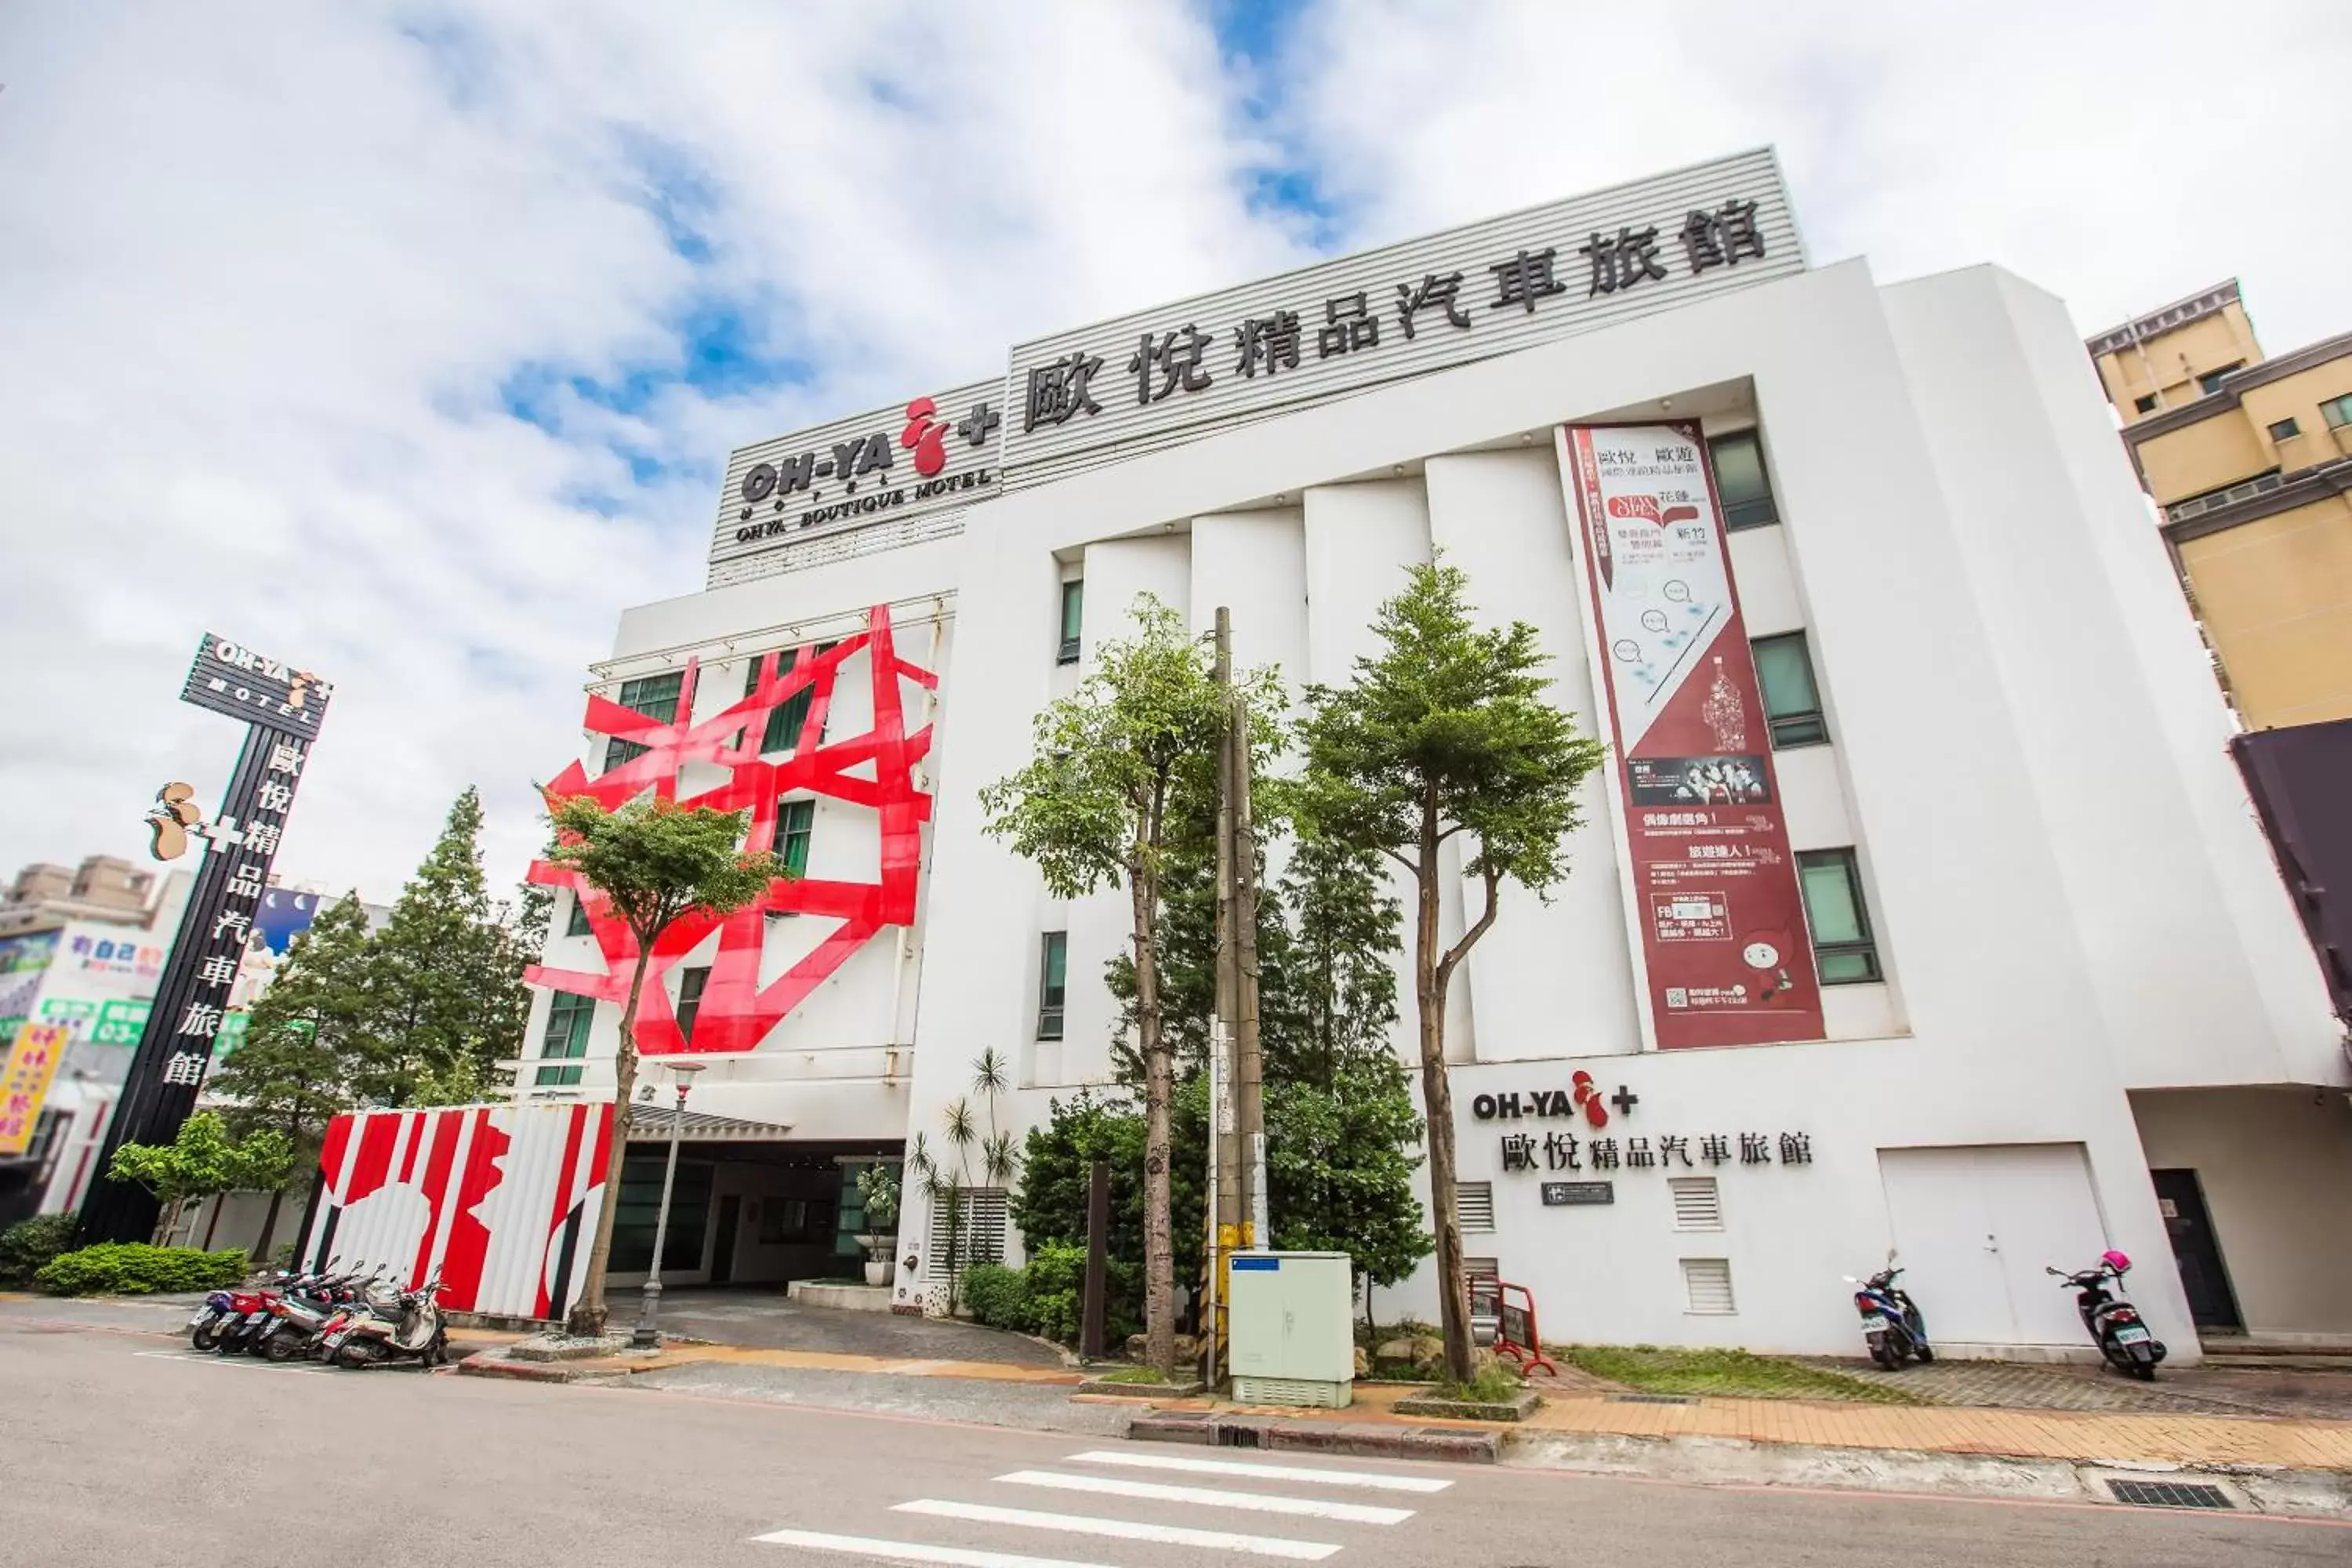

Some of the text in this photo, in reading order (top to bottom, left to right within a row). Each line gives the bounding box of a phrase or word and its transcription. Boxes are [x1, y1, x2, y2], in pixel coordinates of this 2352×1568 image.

[1025, 199, 1766, 433] 歐悅精品汽車旅館
[741, 432, 894, 502] OH-YA
[735, 469, 991, 543] OHYA BOUTIQUE MOTEL
[216, 641, 290, 684] OH-YA
[208, 677, 311, 724] MOTEL
[162, 742, 306, 1087] 歐悅精品汽車旅館
[1473, 1091, 1574, 1120] OH-YA
[1501, 1131, 1814, 1173] 歐悅精品汽車旅館
